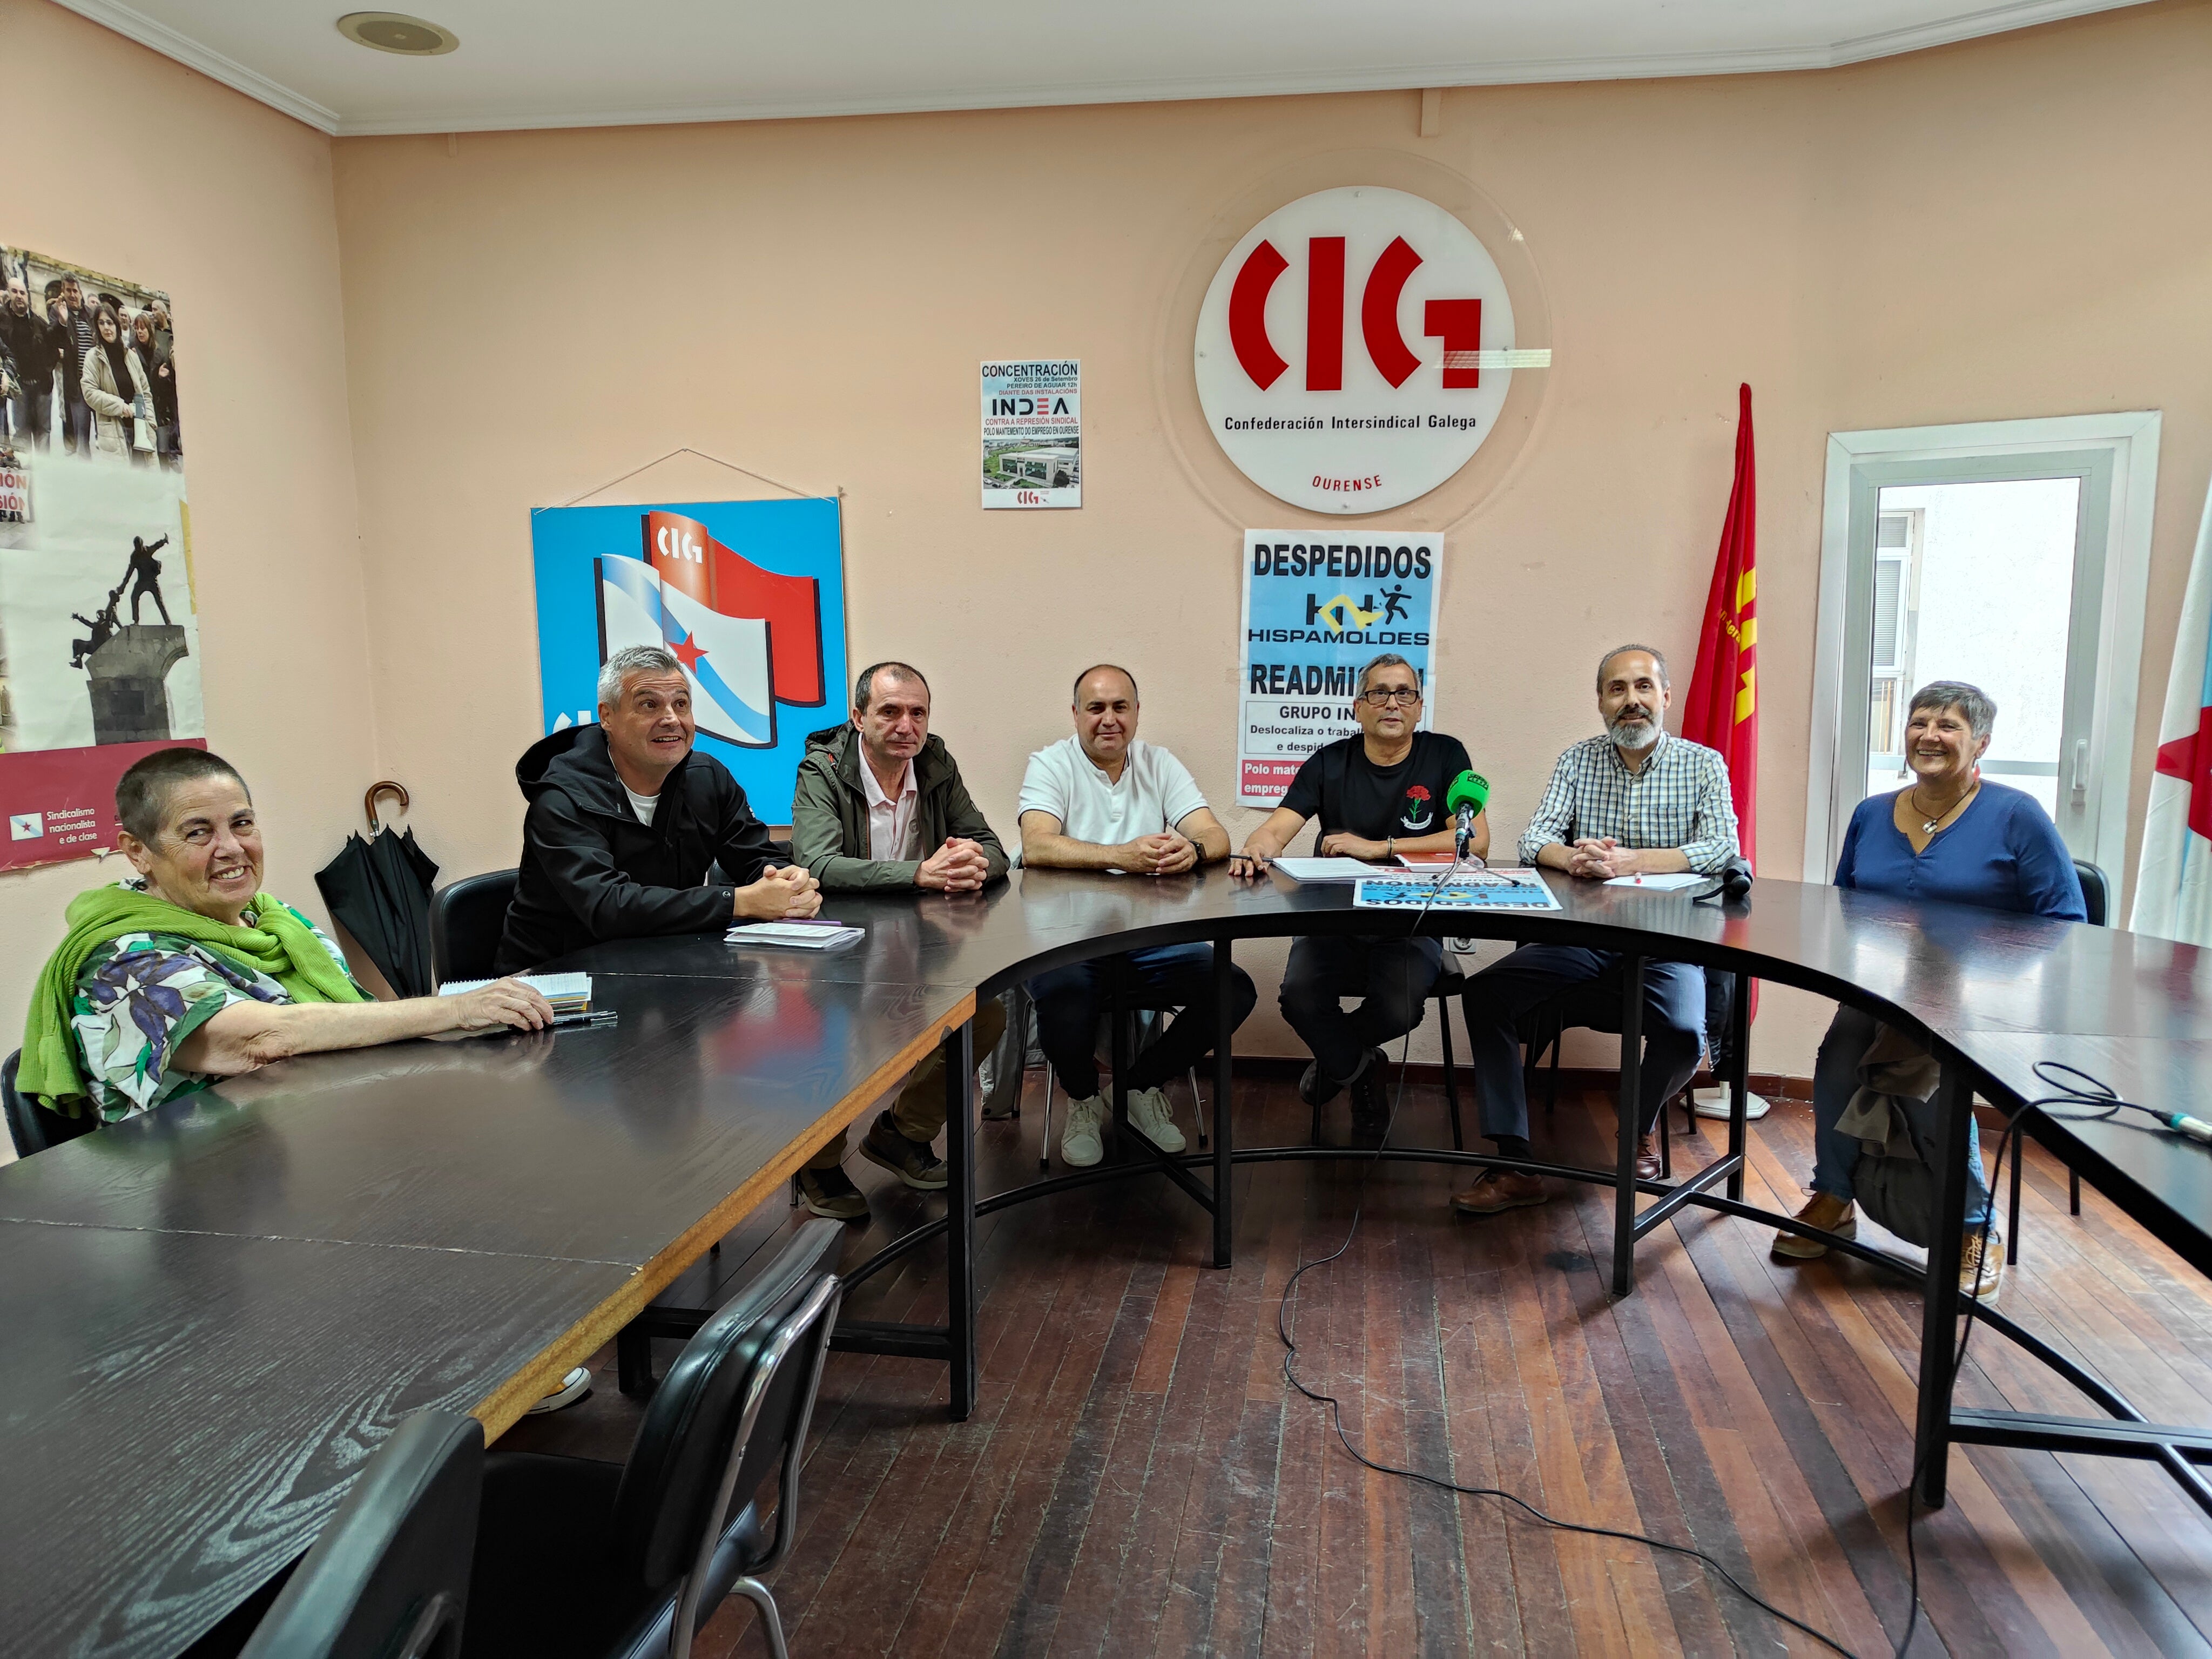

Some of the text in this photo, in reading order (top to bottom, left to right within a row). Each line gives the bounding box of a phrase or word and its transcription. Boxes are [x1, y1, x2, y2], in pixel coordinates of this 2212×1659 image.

[1229, 235, 1481, 392] CIG
[982, 360, 1078, 377] CONCENTRACIÓN
[1016, 416, 1049, 425] REPRESIÓN
[1225, 414, 1476, 431] Confederación Intersindical Galega
[984, 426, 1080, 436] POLO MANTEMENTO DO EMPREGO EN OURENSE
[0, 470, 26, 490] IÓN
[1312, 475, 1382, 492] OURENSE
[1017, 491, 1038, 504] CIG
[657, 526, 703, 564] CIG
[1254, 544, 1431, 579] DESPEDIDOS
[1248, 629, 1429, 646] HISPAMOLDES
[1279, 705, 1331, 719] GRUPO
[1250, 725, 1313, 736] Deslocaliza
[1244, 763, 1270, 774] Polo
[46, 808, 95, 820] Sindicalismo
[49, 820, 96, 833] nacionalista
[66, 834, 77, 844] de
[78, 832, 98, 842] clase
